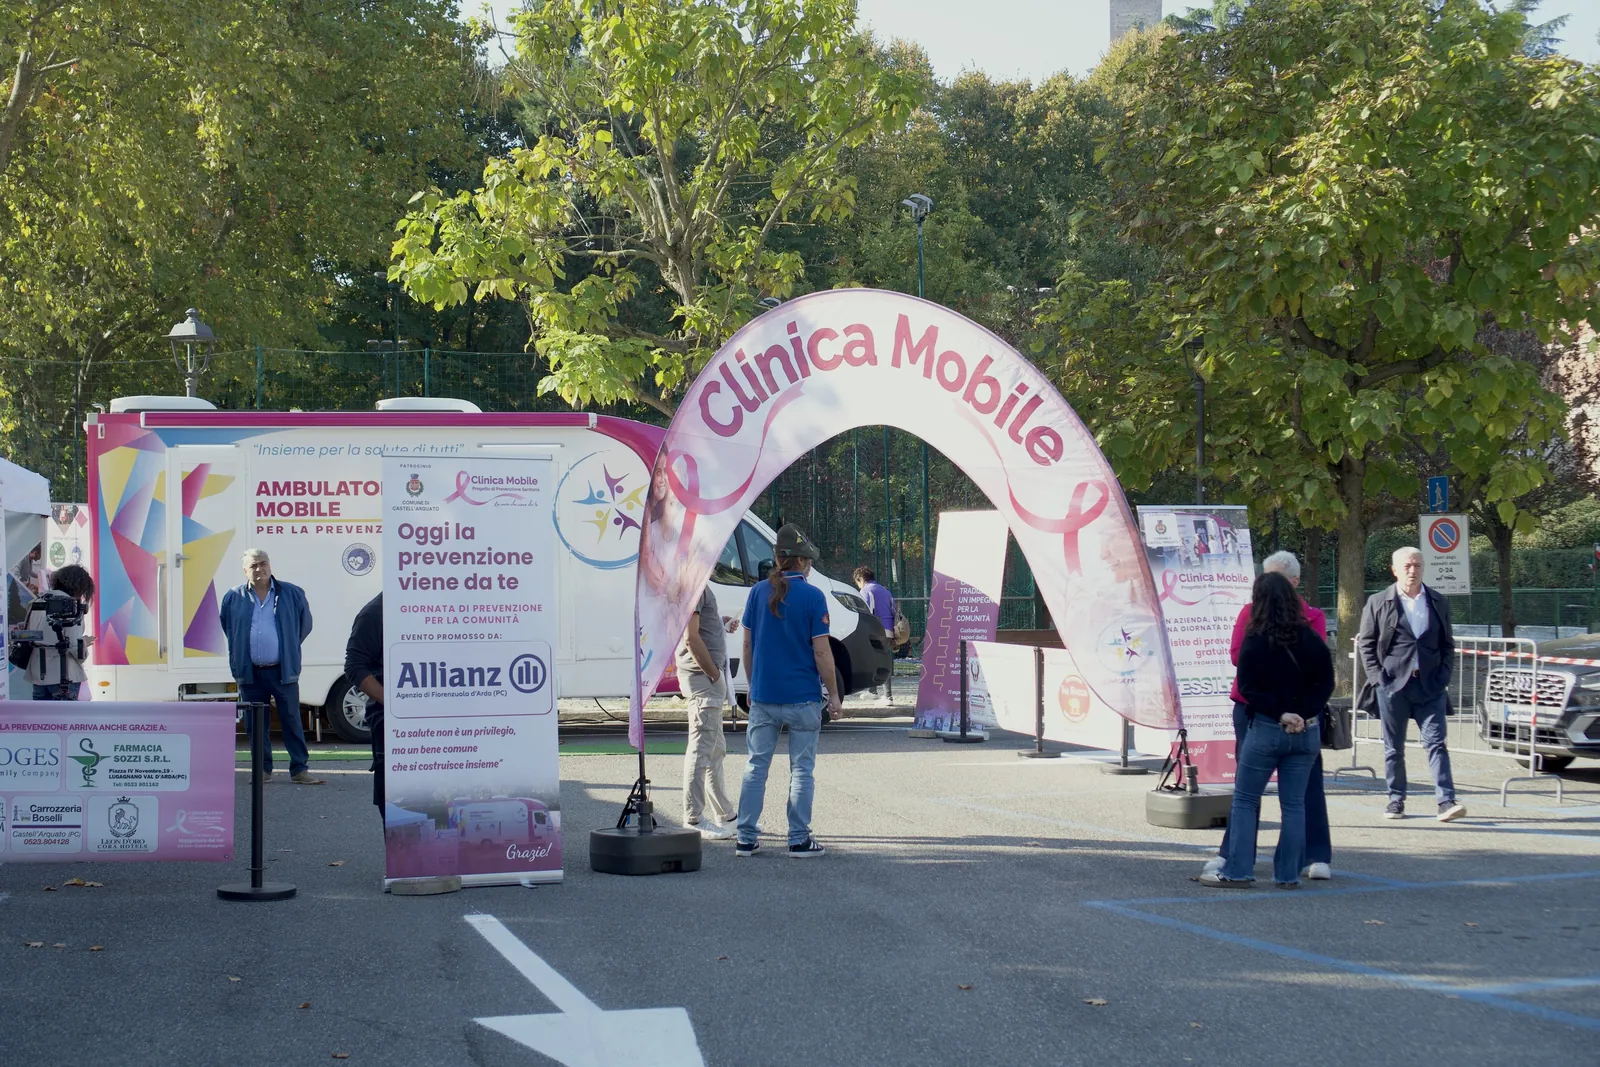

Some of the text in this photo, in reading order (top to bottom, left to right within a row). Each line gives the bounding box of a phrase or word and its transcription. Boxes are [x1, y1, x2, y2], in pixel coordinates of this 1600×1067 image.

[699, 313, 1063, 466] Clinica Mobile
[319, 446, 344, 458] per
[347, 444, 360, 455] la
[471, 476, 538, 486] Clinica Mobile
[256, 481, 383, 496] AMBULATO
[256, 502, 341, 517] MOBILE
[256, 526, 284, 534] PER
[292, 526, 308, 534] LA
[398, 522, 475, 546] Oggi la
[398, 546, 533, 570] prevenzione
[398, 572, 519, 590] viene da te
[1179, 573, 1248, 583] Clinica Mobile
[400, 605, 456, 613] GIORNATA
[473, 604, 542, 612] PREVENZIONE
[462, 614, 519, 624] COMUNITÀ
[956, 613, 990, 622] COMUNITÀ
[1204, 638, 1231, 647] preve
[397, 662, 502, 688] Allianz
[1176, 676, 1236, 695] ESSIL
[408, 728, 435, 738] salute
[454, 728, 460, 736] è
[474, 726, 516, 738] privilegio,
[420, 745, 441, 754] bene
[392, 762, 408, 771] che
[409, 762, 417, 771] si
[418, 761, 464, 770] costruisce
[22, 770, 59, 778] Company
[30, 805, 82, 813] Carrozzeria
[506, 842, 552, 862] Grazie!
